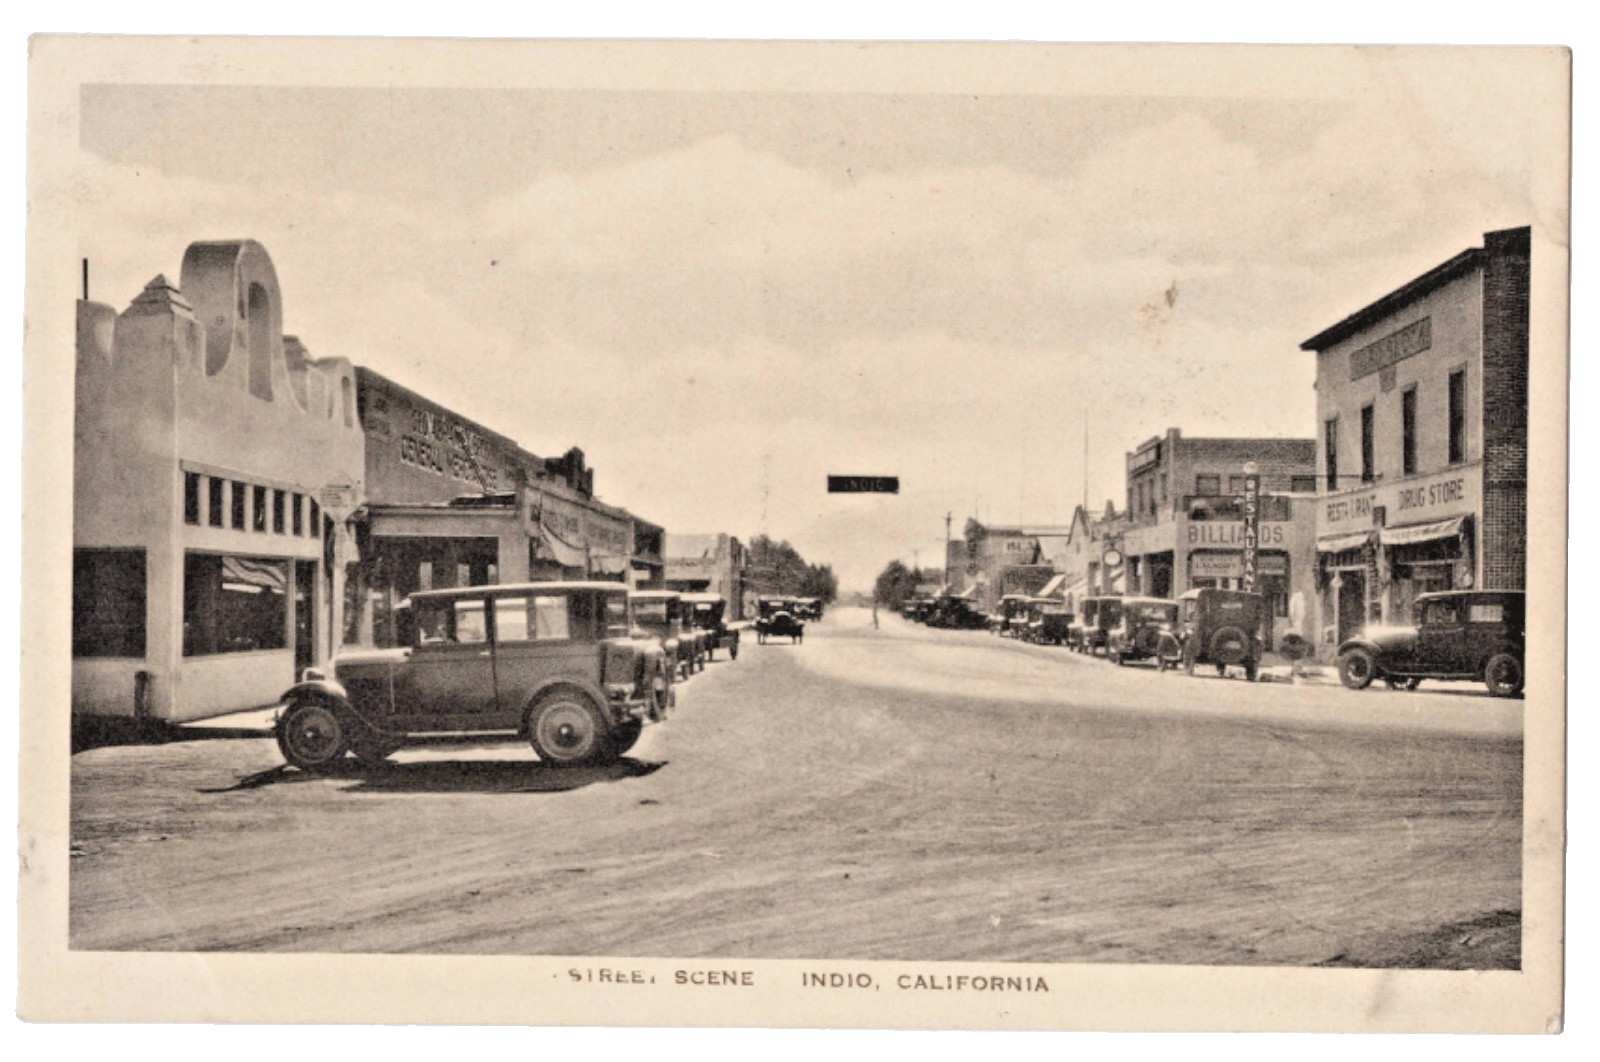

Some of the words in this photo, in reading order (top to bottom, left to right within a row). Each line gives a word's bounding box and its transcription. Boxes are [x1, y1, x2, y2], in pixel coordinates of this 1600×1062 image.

[1399, 487, 1426, 511] DRUG
[1429, 478, 1465, 506] STORE
[1188, 525, 1284, 544] BILLIADS
